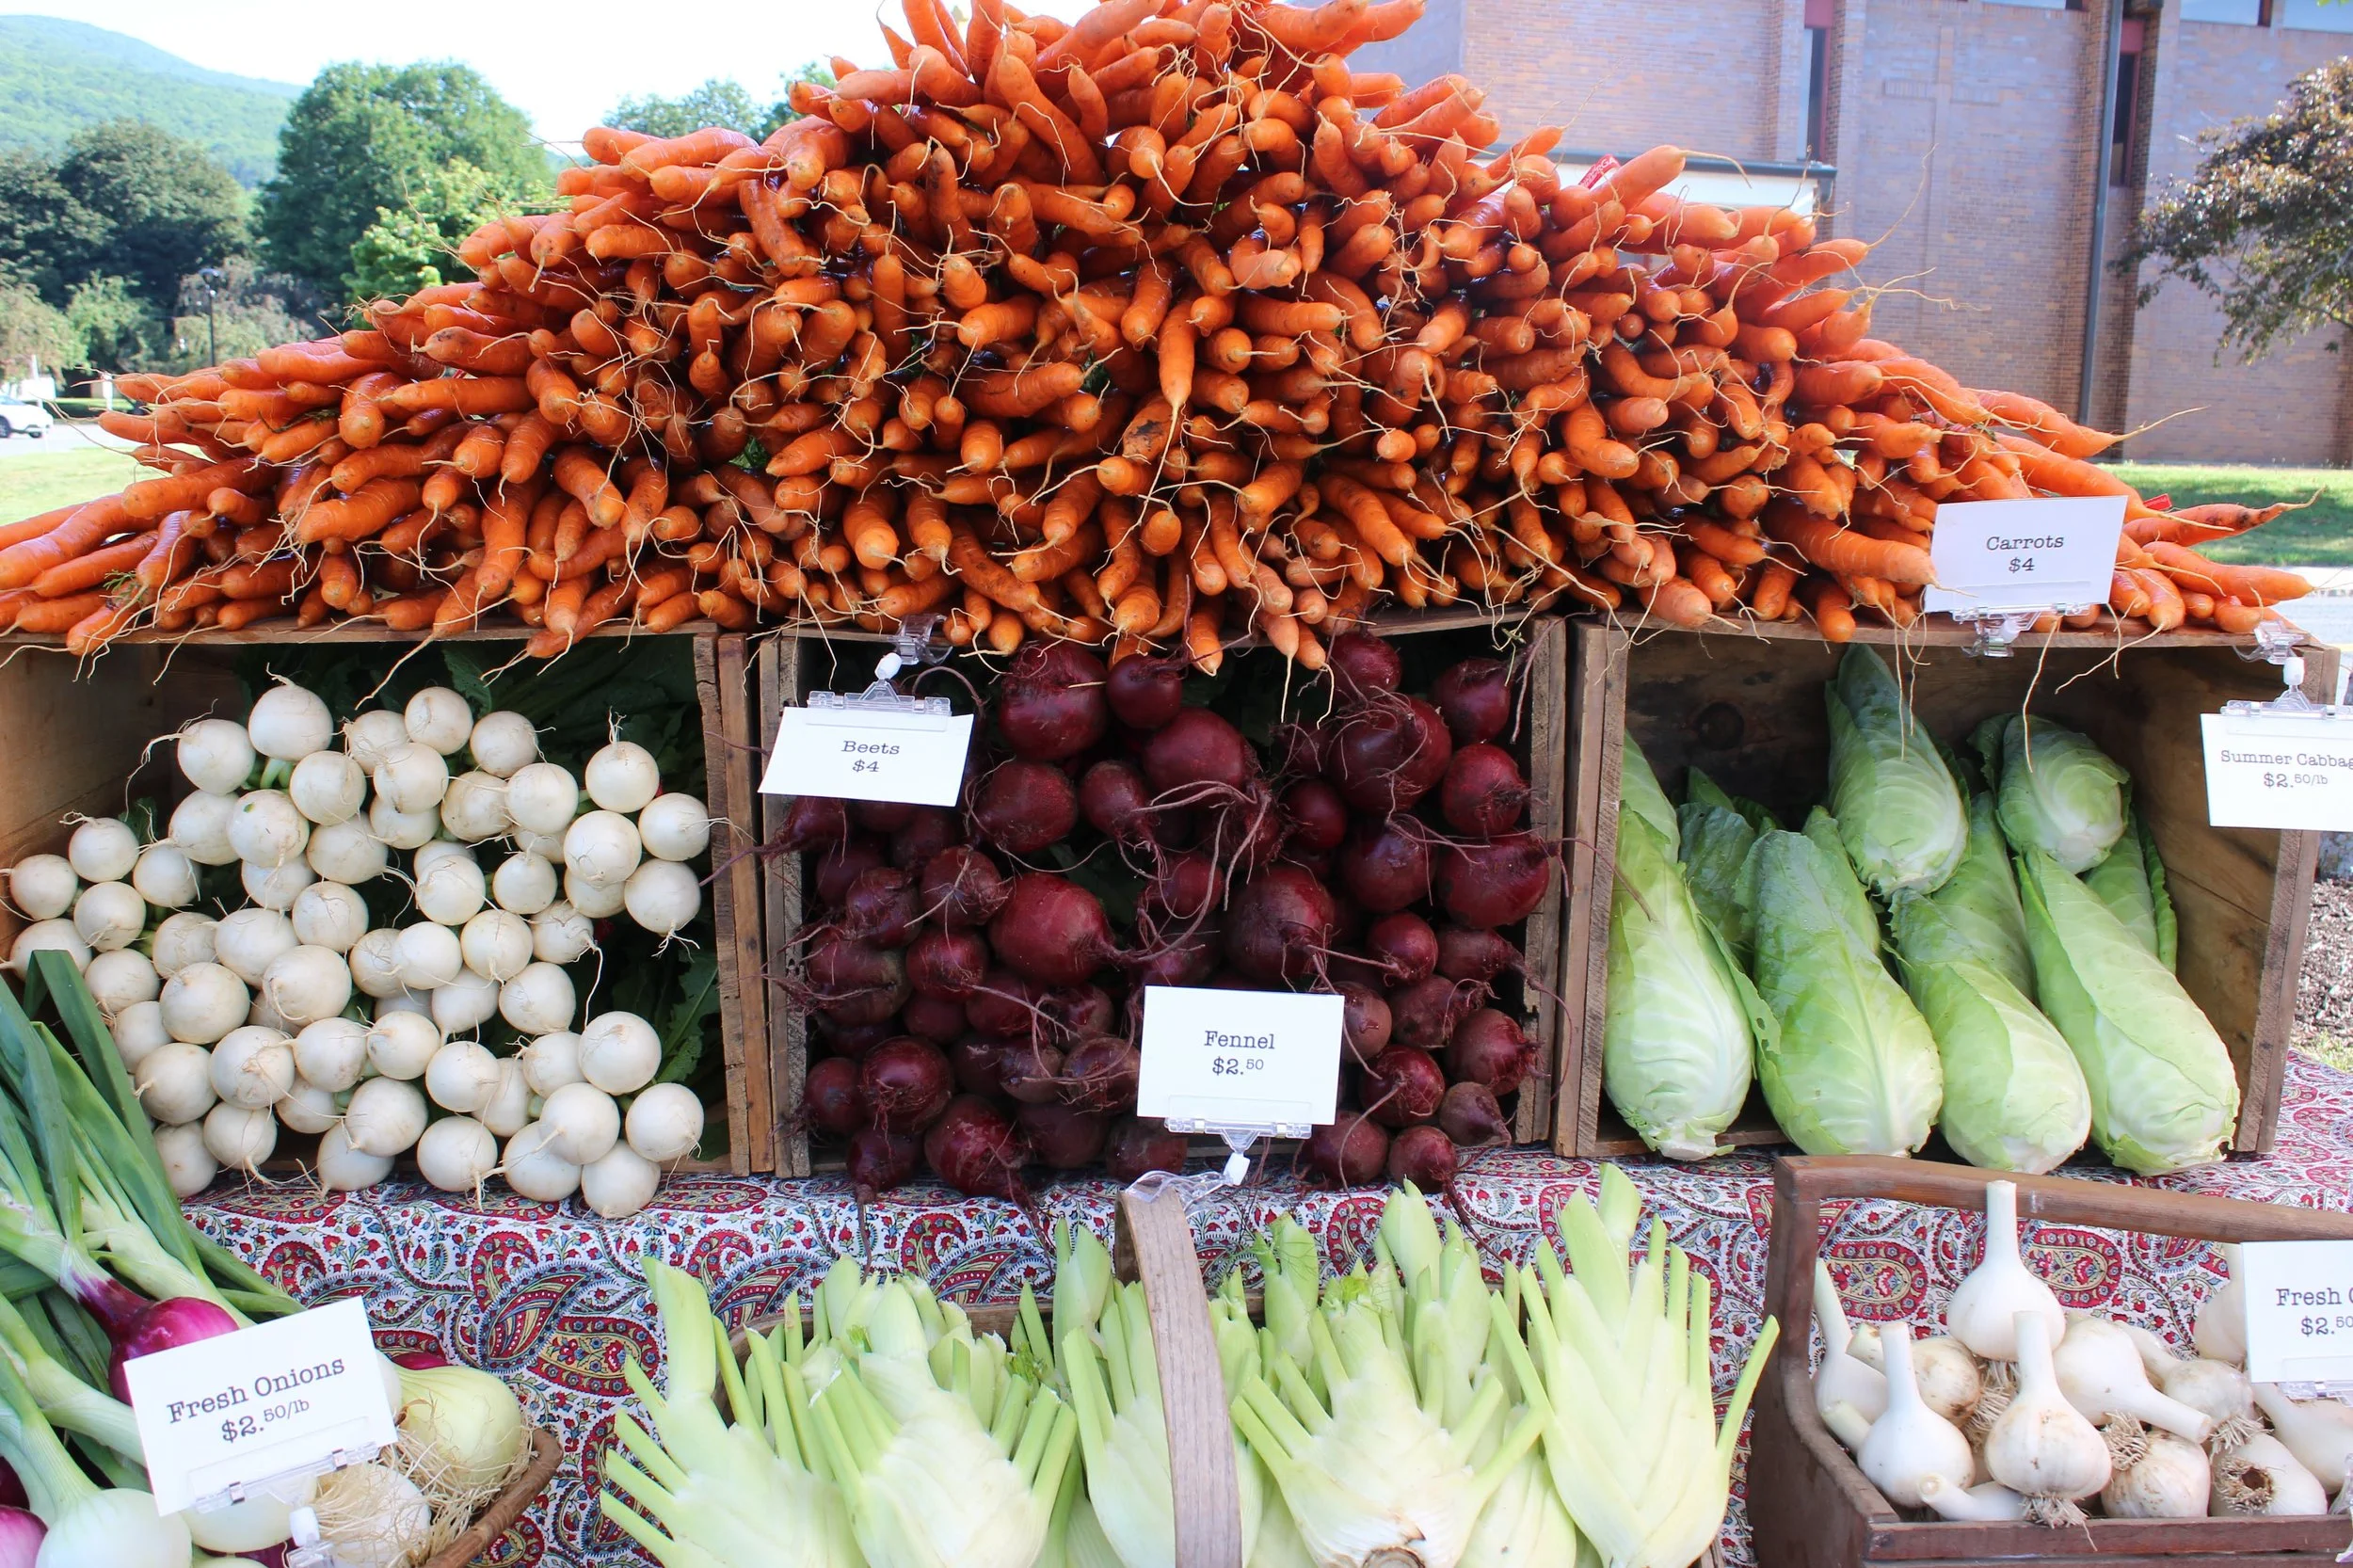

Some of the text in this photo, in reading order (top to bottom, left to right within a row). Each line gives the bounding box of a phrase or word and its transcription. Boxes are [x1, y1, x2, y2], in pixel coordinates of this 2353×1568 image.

[1986, 535, 2065, 552] Carrots
[2008, 556, 2036, 574] $4
[840, 740, 901, 755] Beets
[852, 758, 880, 773] $4
[2220, 749, 2293, 765] Summer
[1203, 1030, 1275, 1050] Fennel
[1211, 1055, 1264, 1077] $2.50
[2275, 1287, 2343, 1306] Fresh
[166, 1358, 345, 1424] Fresh Onions
